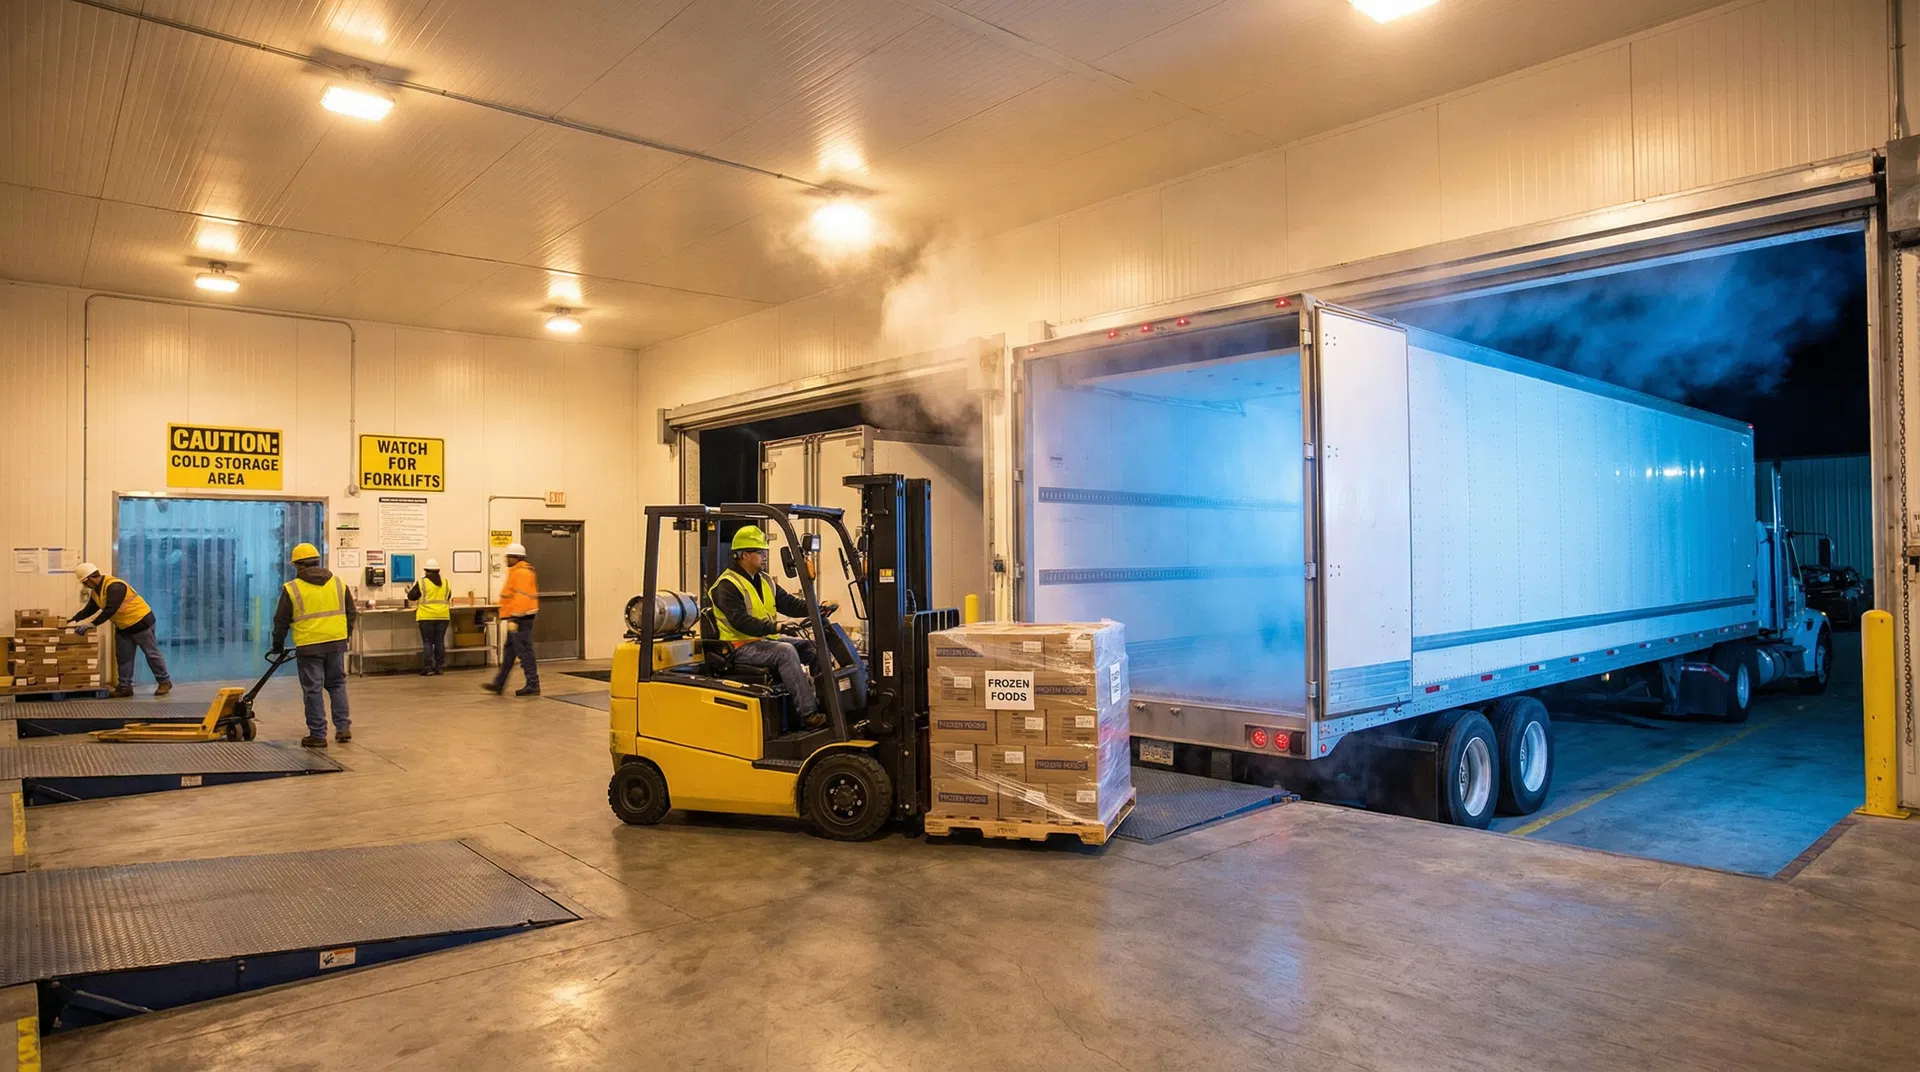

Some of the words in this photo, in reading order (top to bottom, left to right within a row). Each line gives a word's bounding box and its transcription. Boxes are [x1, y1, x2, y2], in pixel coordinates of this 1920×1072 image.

[173, 429, 278, 453] CAUTION:
[377, 440, 428, 455] WATCH
[171, 454, 210, 469] COLD
[215, 457, 279, 471] STORAGE
[388, 456, 416, 470] FOR
[207, 472, 245, 485] AREA
[364, 472, 440, 488] FORKLIFTS
[549, 491, 564, 503] EXIT
[988, 679, 1030, 689] FROZEN
[991, 692, 1027, 702] FOODS
